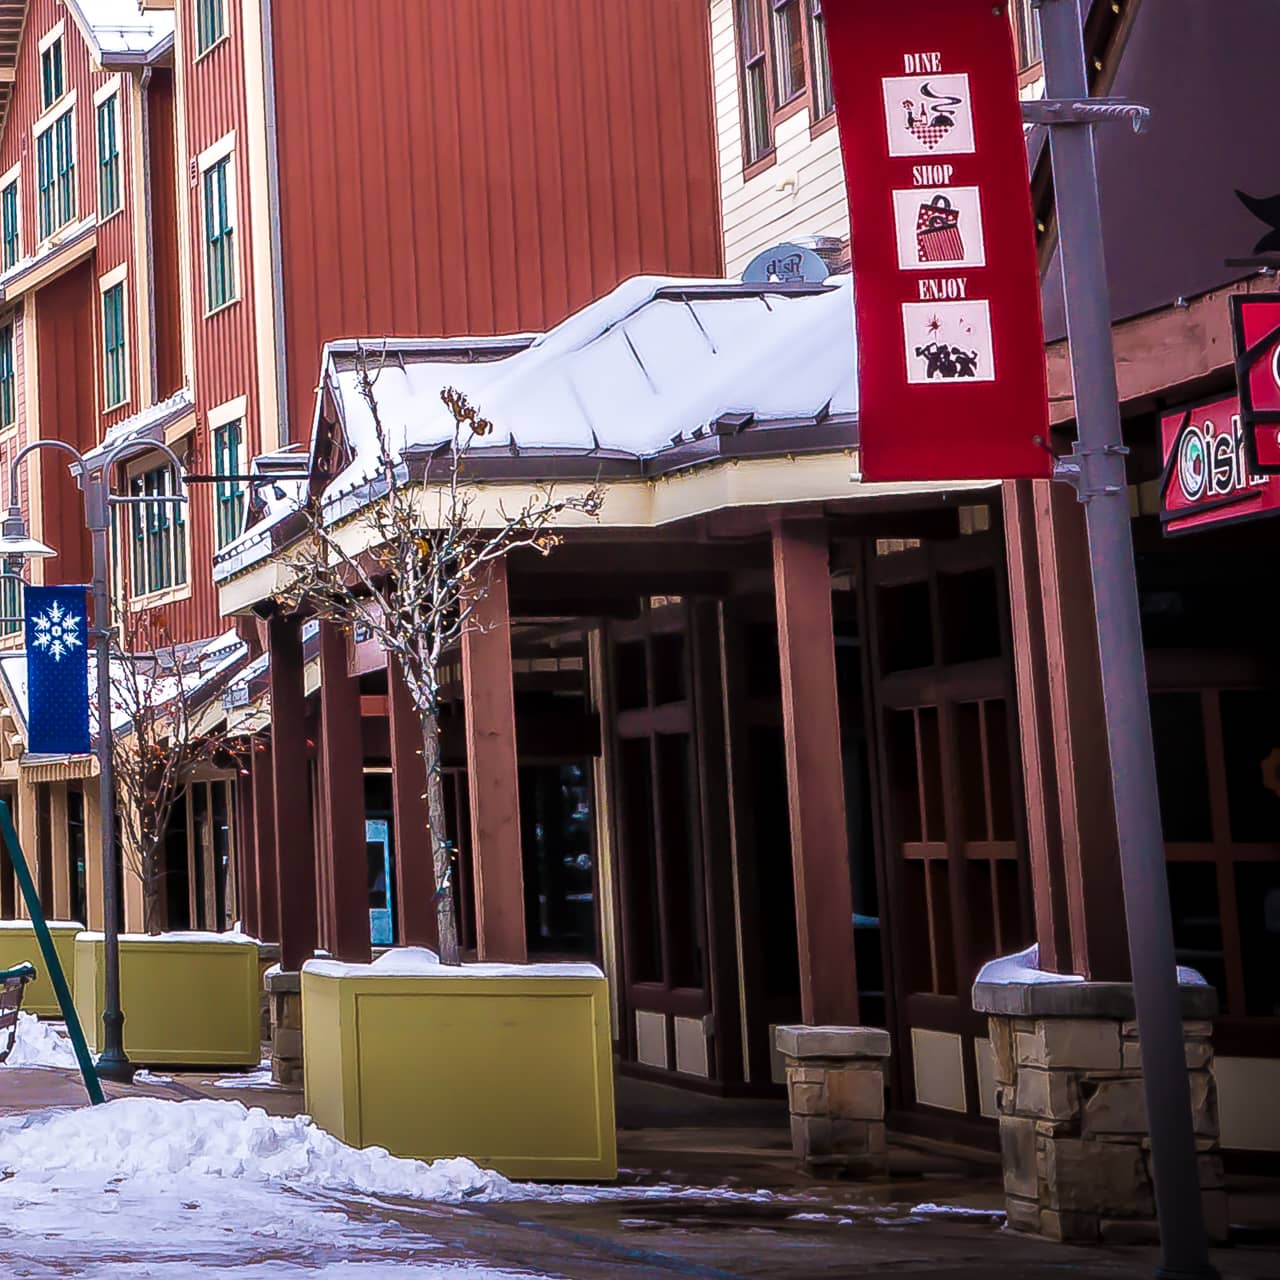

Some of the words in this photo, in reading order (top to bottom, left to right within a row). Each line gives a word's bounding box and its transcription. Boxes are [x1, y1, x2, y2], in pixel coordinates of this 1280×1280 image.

[903, 51, 942, 74] DINE
[912, 163, 954, 186] SHOP
[918, 277, 967, 300] ENJOY
